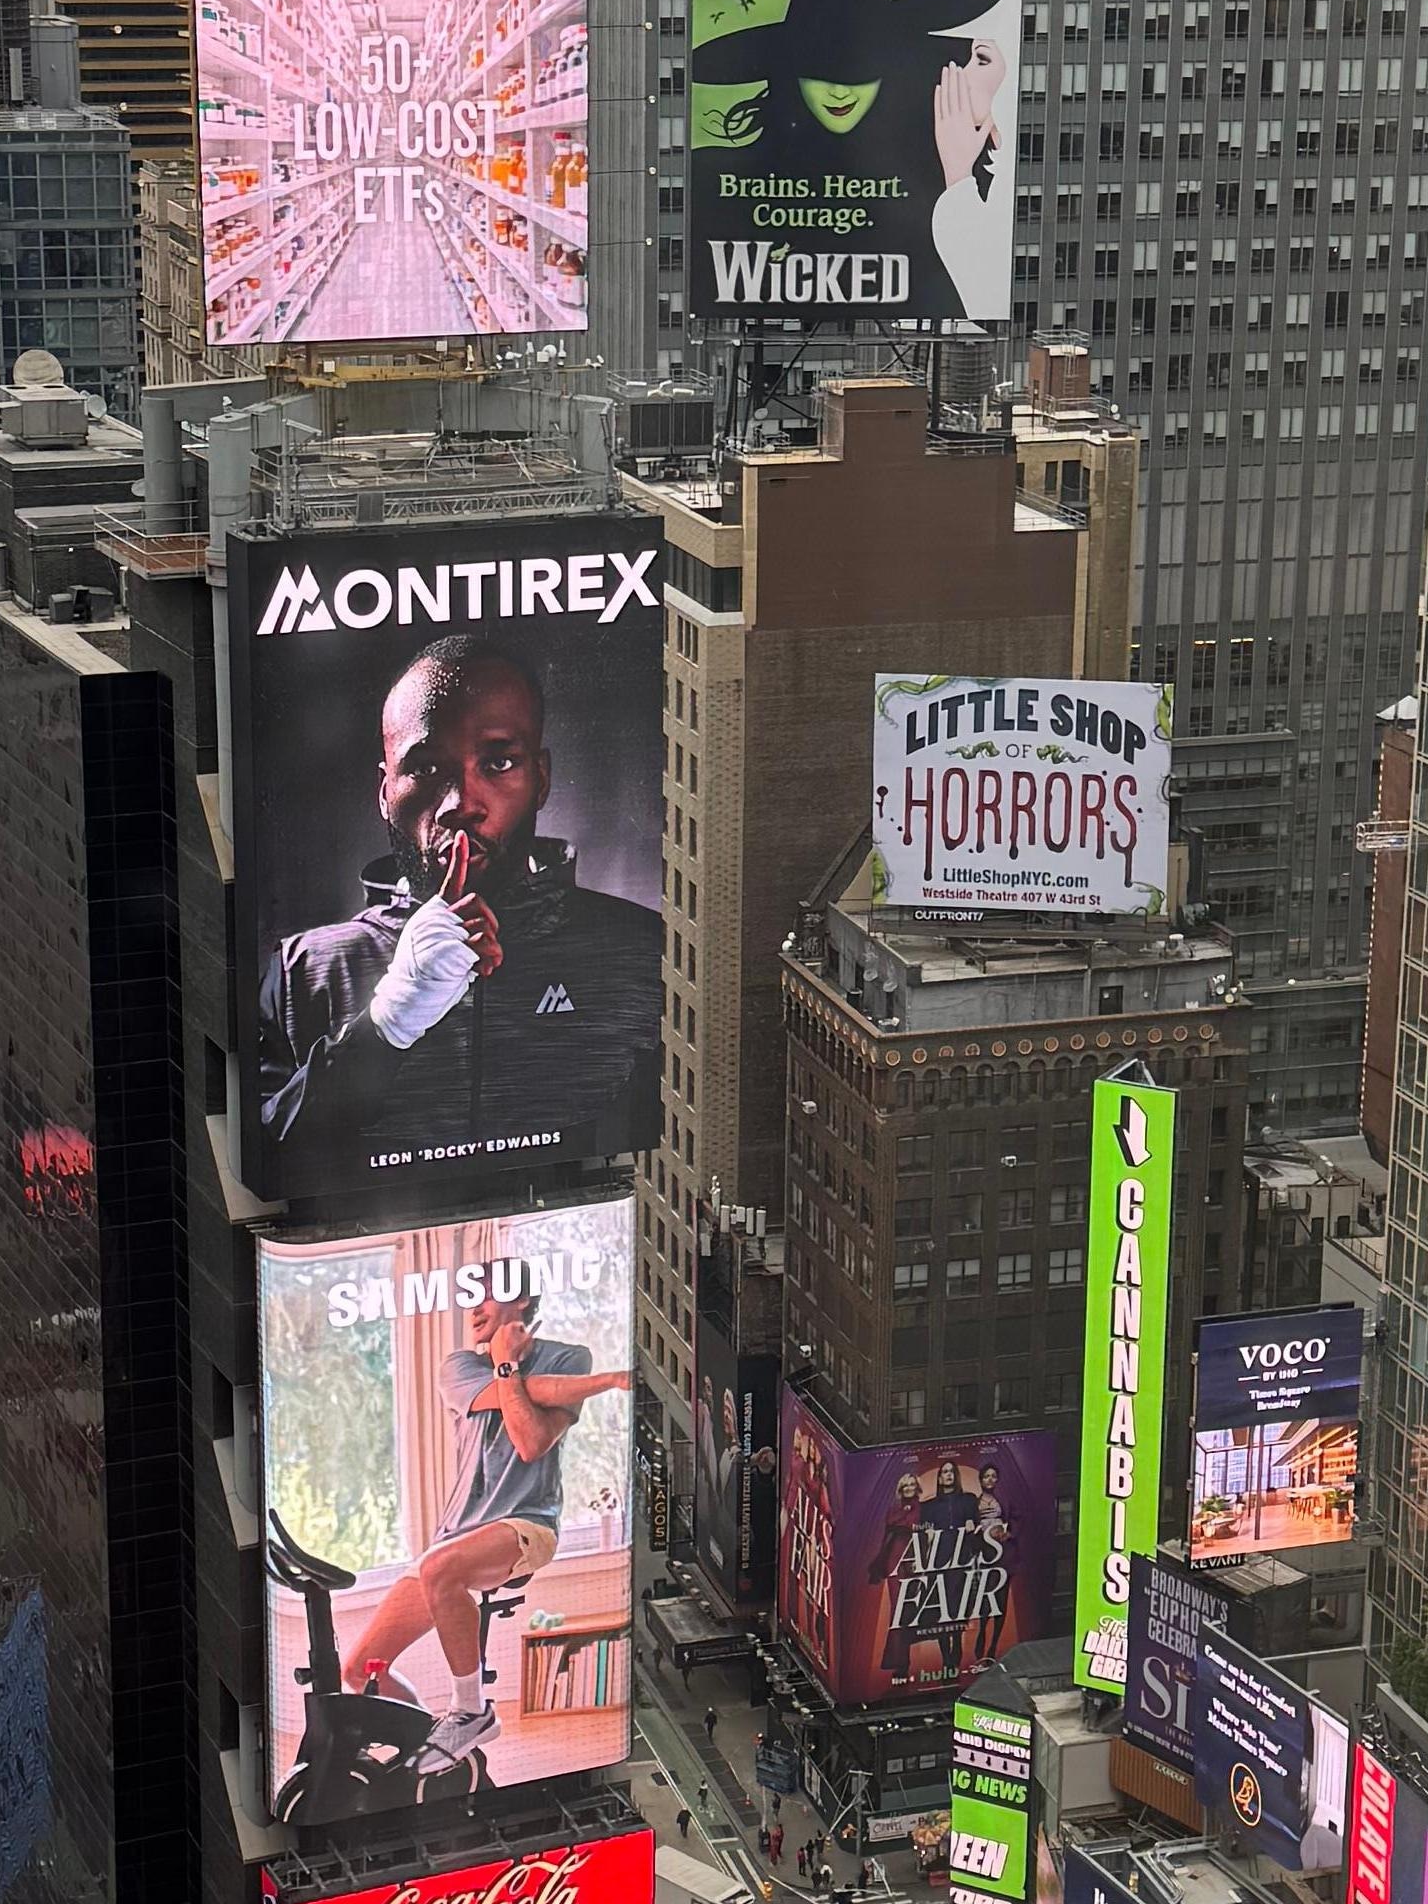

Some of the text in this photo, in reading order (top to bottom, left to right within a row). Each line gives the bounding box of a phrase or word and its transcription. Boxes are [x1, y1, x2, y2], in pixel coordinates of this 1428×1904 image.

[359, 35, 432, 96] 50+
[293, 98, 501, 161] LOW-COST
[354, 168, 445, 226] ETFs
[719, 172, 909, 201] Brains. Heart.
[752, 204, 875, 235] Courage.
[256, 548, 659, 637] MONTIREX
[905, 689, 1147, 765] LITTLE SHOP
[1005, 742, 1032, 759] OF
[902, 766, 1141, 866] HORRORS
[923, 887, 972, 900] Westside
[1021, 892, 1042, 903] 407
[1046, 893, 1056, 903] W
[1059, 894, 1085, 905] 43rd
[1089, 894, 1101, 905] St
[943, 868, 1089, 888] LittleShopNYC.com
[369, 1150, 413, 1167] LEON
[486, 1131, 561, 1153] EDWARDS
[327, 1250, 602, 1328] SAMSUNG
[1105, 1176, 1145, 1606] CANNABIS
[889, 1523, 1008, 1577] ALL'S
[888, 1566, 1008, 1629] FAIR
[1151, 1567, 1229, 1622] BROADWAY'S
[919, 1667, 960, 1683] hulu
[974, 1774, 1027, 1804] NEWS
